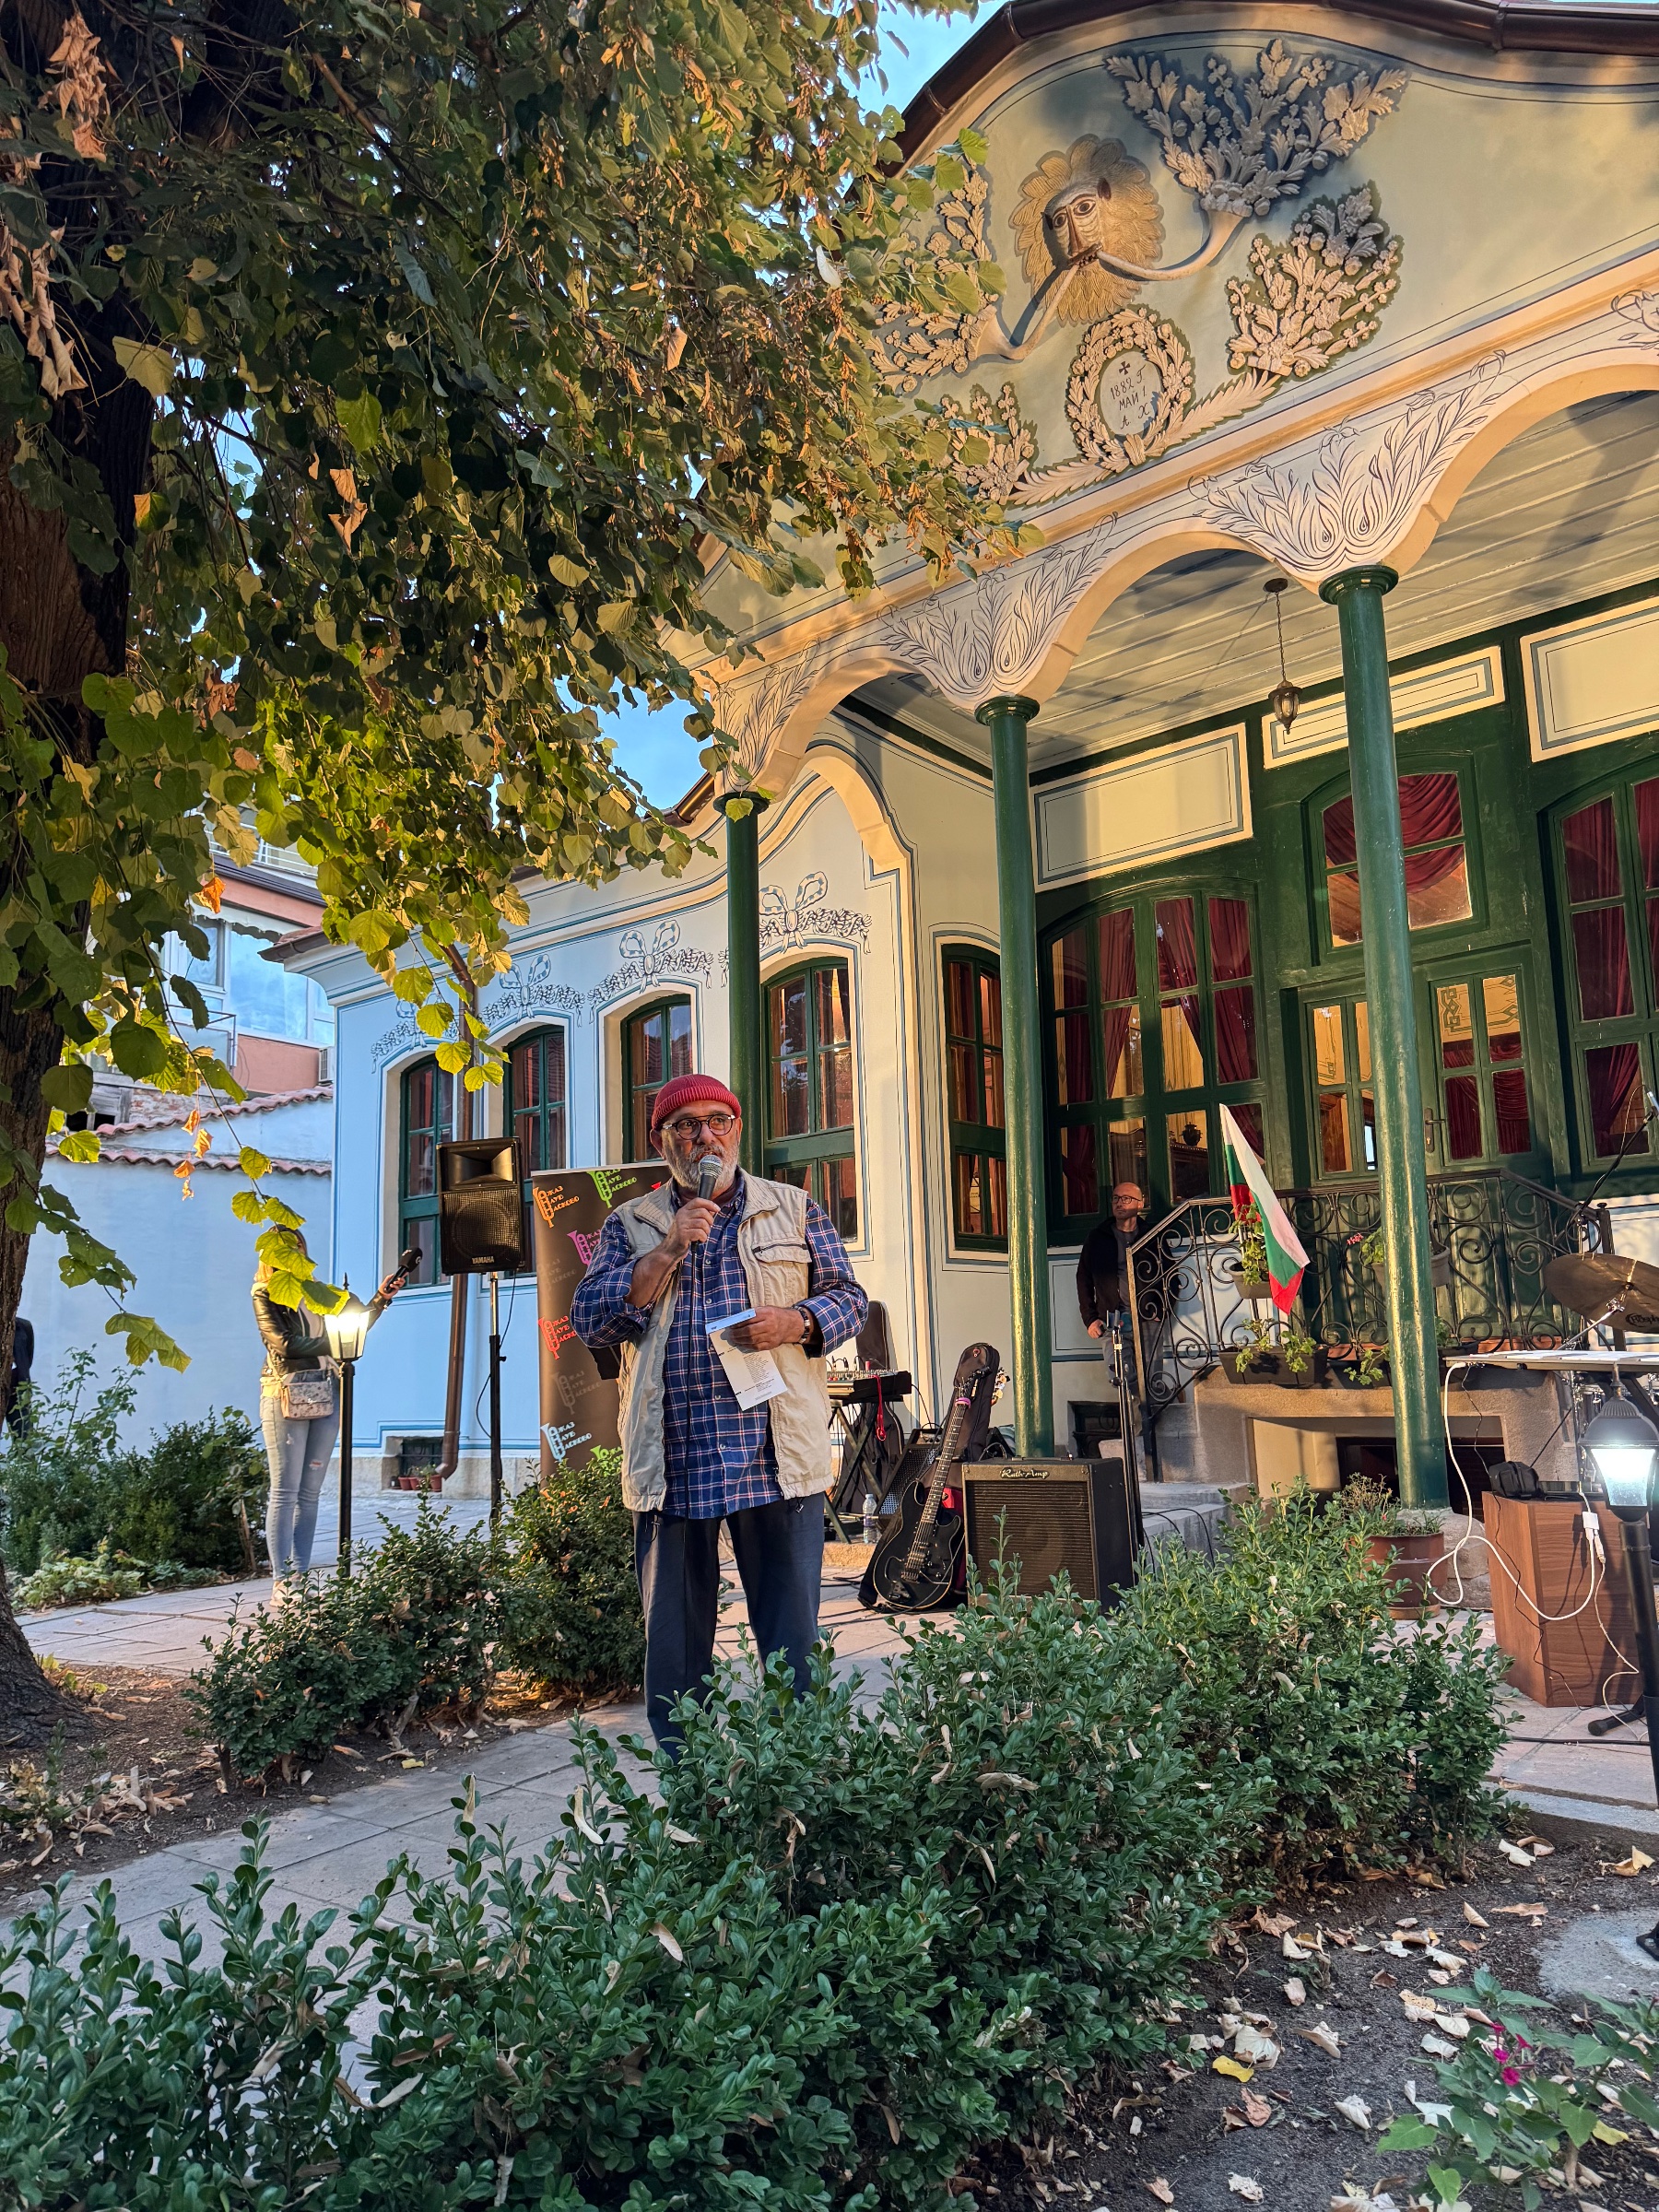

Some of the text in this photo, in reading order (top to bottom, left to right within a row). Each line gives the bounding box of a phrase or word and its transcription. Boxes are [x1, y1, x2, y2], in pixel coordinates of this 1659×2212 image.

[1110, 377, 1135, 400] 1882
[1119, 390, 1139, 411] МАЙ
[471, 1255, 495, 1264] YAMAHA
